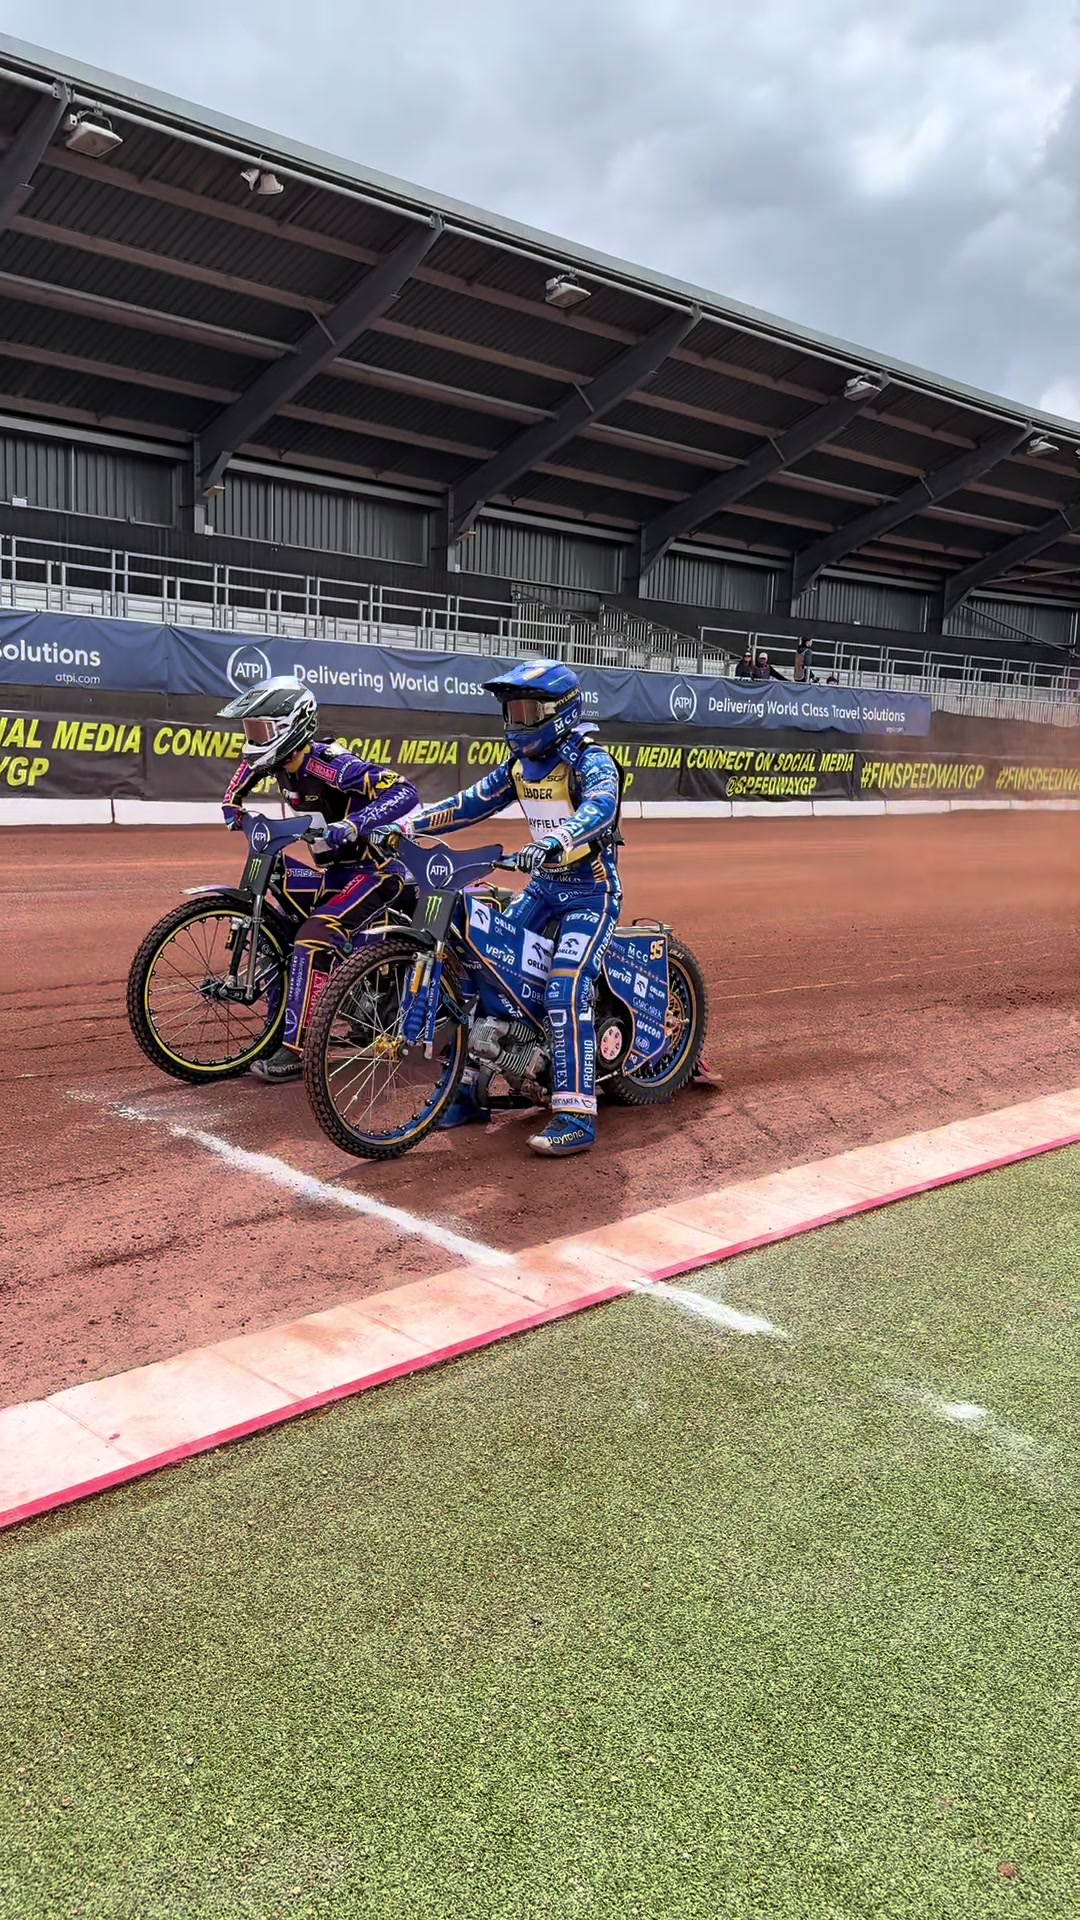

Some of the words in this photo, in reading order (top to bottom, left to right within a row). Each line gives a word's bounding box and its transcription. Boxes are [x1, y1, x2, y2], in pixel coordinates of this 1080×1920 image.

[0, 639, 101, 667] olutions
[55, 673, 101, 685] atpi.com
[234, 661, 264, 679] ATPI
[293, 663, 384, 692] Delivering
[390, 671, 439, 693] World
[448, 676, 485, 697] Class
[673, 696, 693, 709] ATPI
[708, 697, 765, 718] Delivering
[767, 701, 799, 716] World
[801, 703, 829, 717] Class
[832, 704, 860, 720] Travel
[862, 708, 905, 722] Solutions
[0, 716, 42, 748] IAL
[51, 720, 142, 753] MEDIA
[153, 727, 246, 759] CONNE
[397, 739, 458, 765] MEDIA
[636, 747, 682, 769] MEDIA
[687, 748, 752, 771] CONNECT
[755, 752, 772, 772] ON
[773, 752, 816, 772] SOCIAL
[818, 753, 855, 772] MEDIA
[726, 775, 817, 796] @SPEEDWAYGP
[860, 761, 985, 789] #FIMSPEEDWAYGP
[430, 865, 449, 876] ATPI
[650, 939, 665, 960] 95
[527, 958, 549, 974] ORLEN
[608, 967, 632, 985] verva
[552, 1028, 568, 1088] DRUTEX
[583, 1039, 594, 1089] PROFBUD
